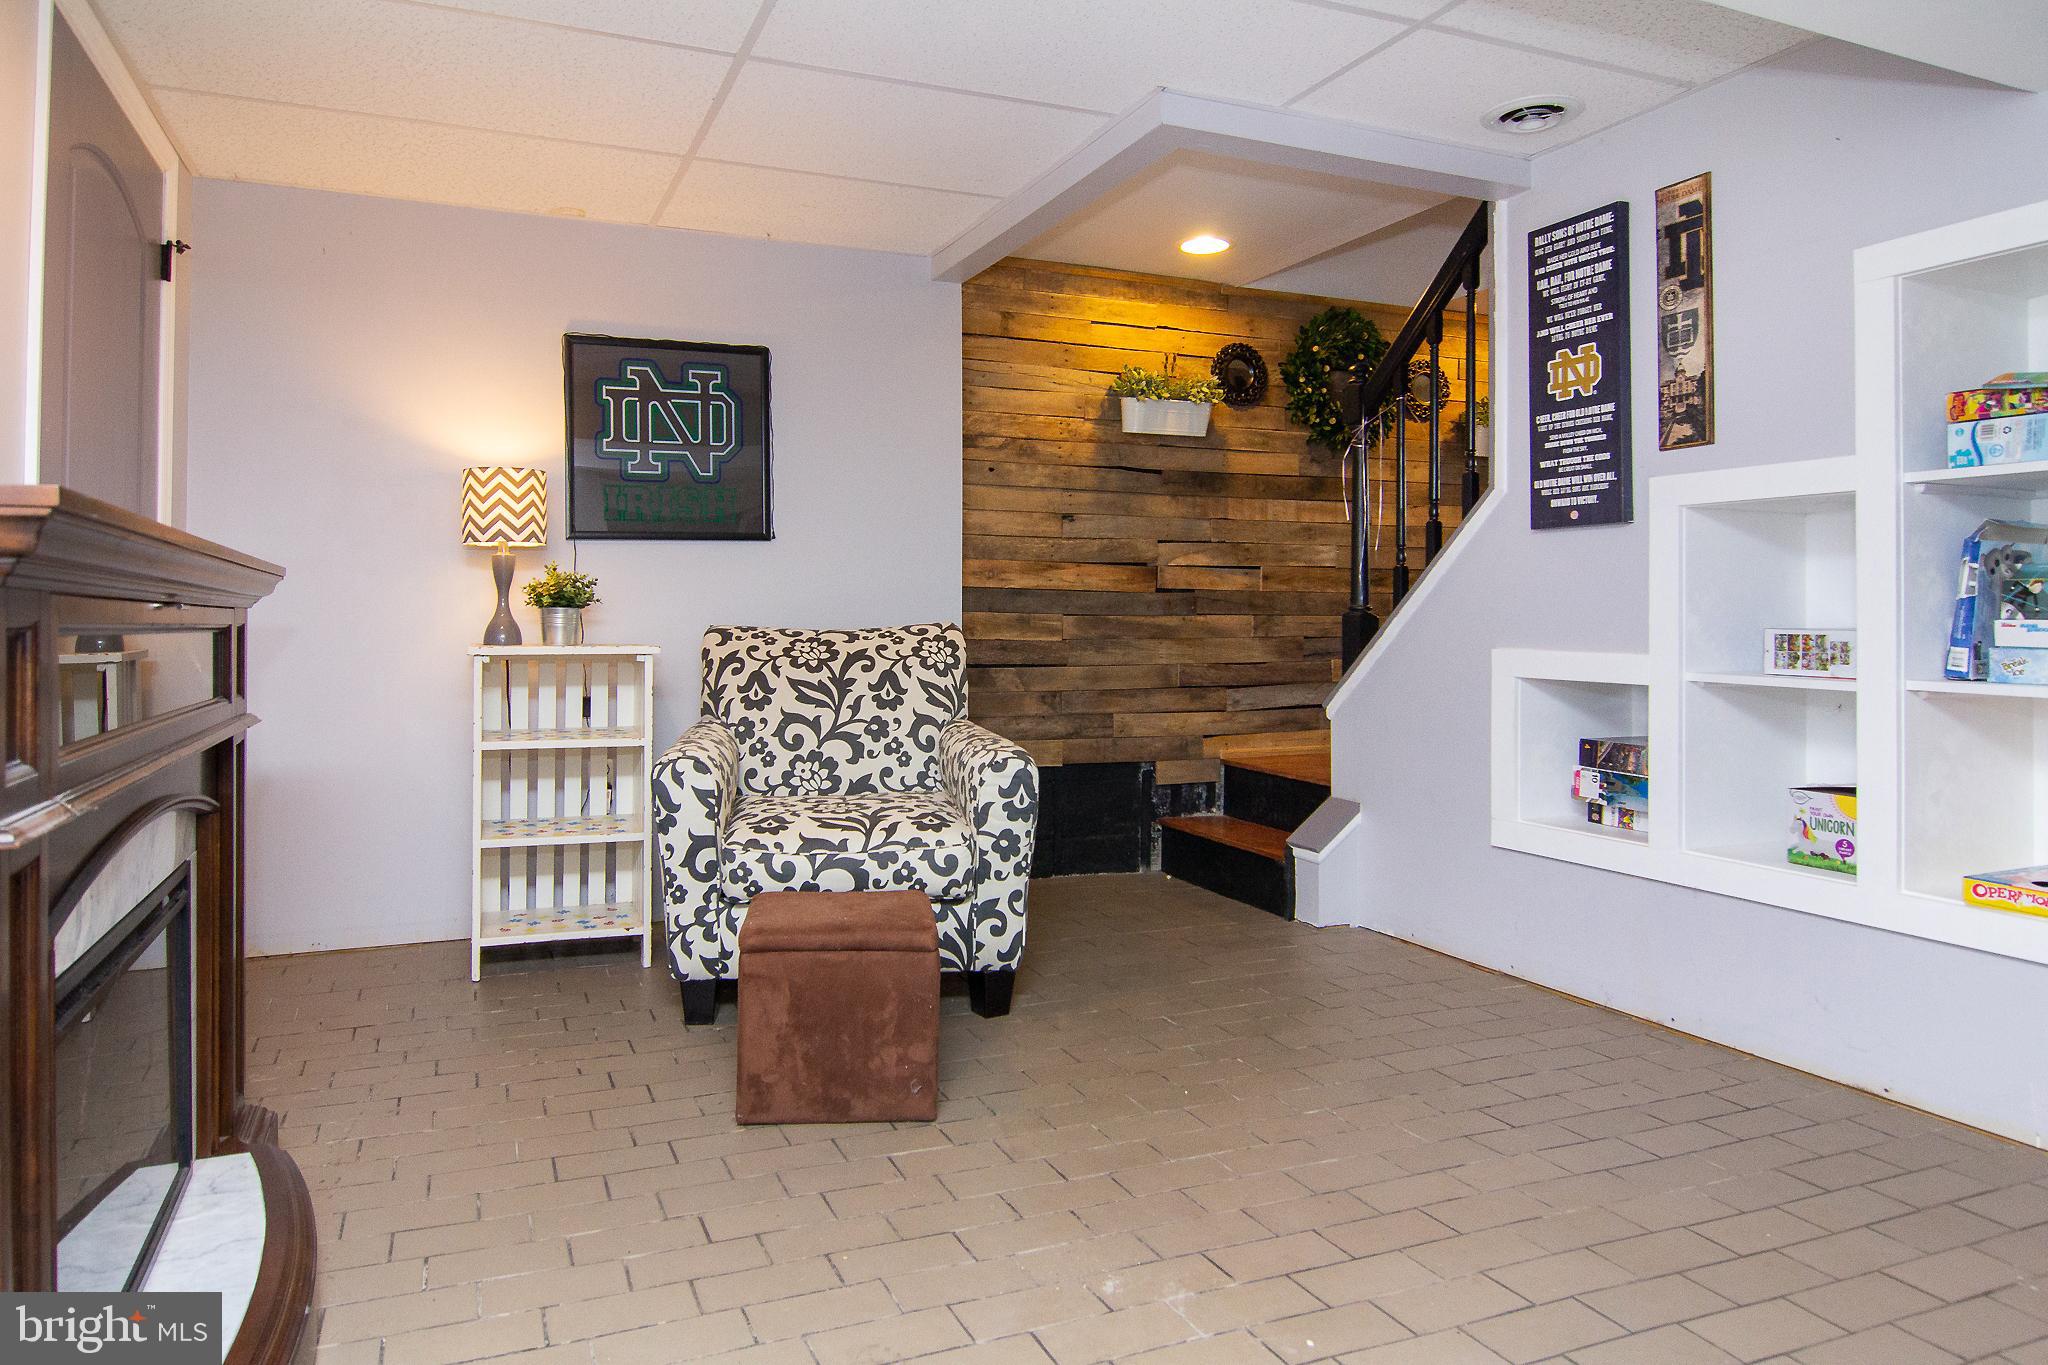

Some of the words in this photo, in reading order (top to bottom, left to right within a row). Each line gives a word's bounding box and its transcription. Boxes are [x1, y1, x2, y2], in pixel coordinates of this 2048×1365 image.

[1535, 233, 1551, 247] RALLY
[1552, 228, 1567, 241] SONS
[1568, 224, 1575, 236] OF
[1575, 218, 1594, 233] NOTRE
[1564, 271, 1575, 282] FOR
[1575, 265, 1594, 279] NOTRE
[1595, 260, 1612, 273] DAME
[1537, 329, 1549, 338] AND
[1549, 325, 1564, 334] WILL
[1597, 313, 1613, 322] EVER
[1567, 410, 1575, 419] FOR
[1585, 405, 1600, 415] NOTRE
[1601, 402, 1615, 412] DAME
[1540, 460, 1558, 468] WHAT
[1543, 479, 1557, 488] NOTRE
[1558, 477, 1571, 486] DAME
[1572, 475, 1583, 484] WILL
[1583, 474, 1593, 483] WIN
[1594, 473, 1606, 481] OVER
[1810, 816, 1855, 836] UNICORN
[1842, 840, 1848, 848] 5
